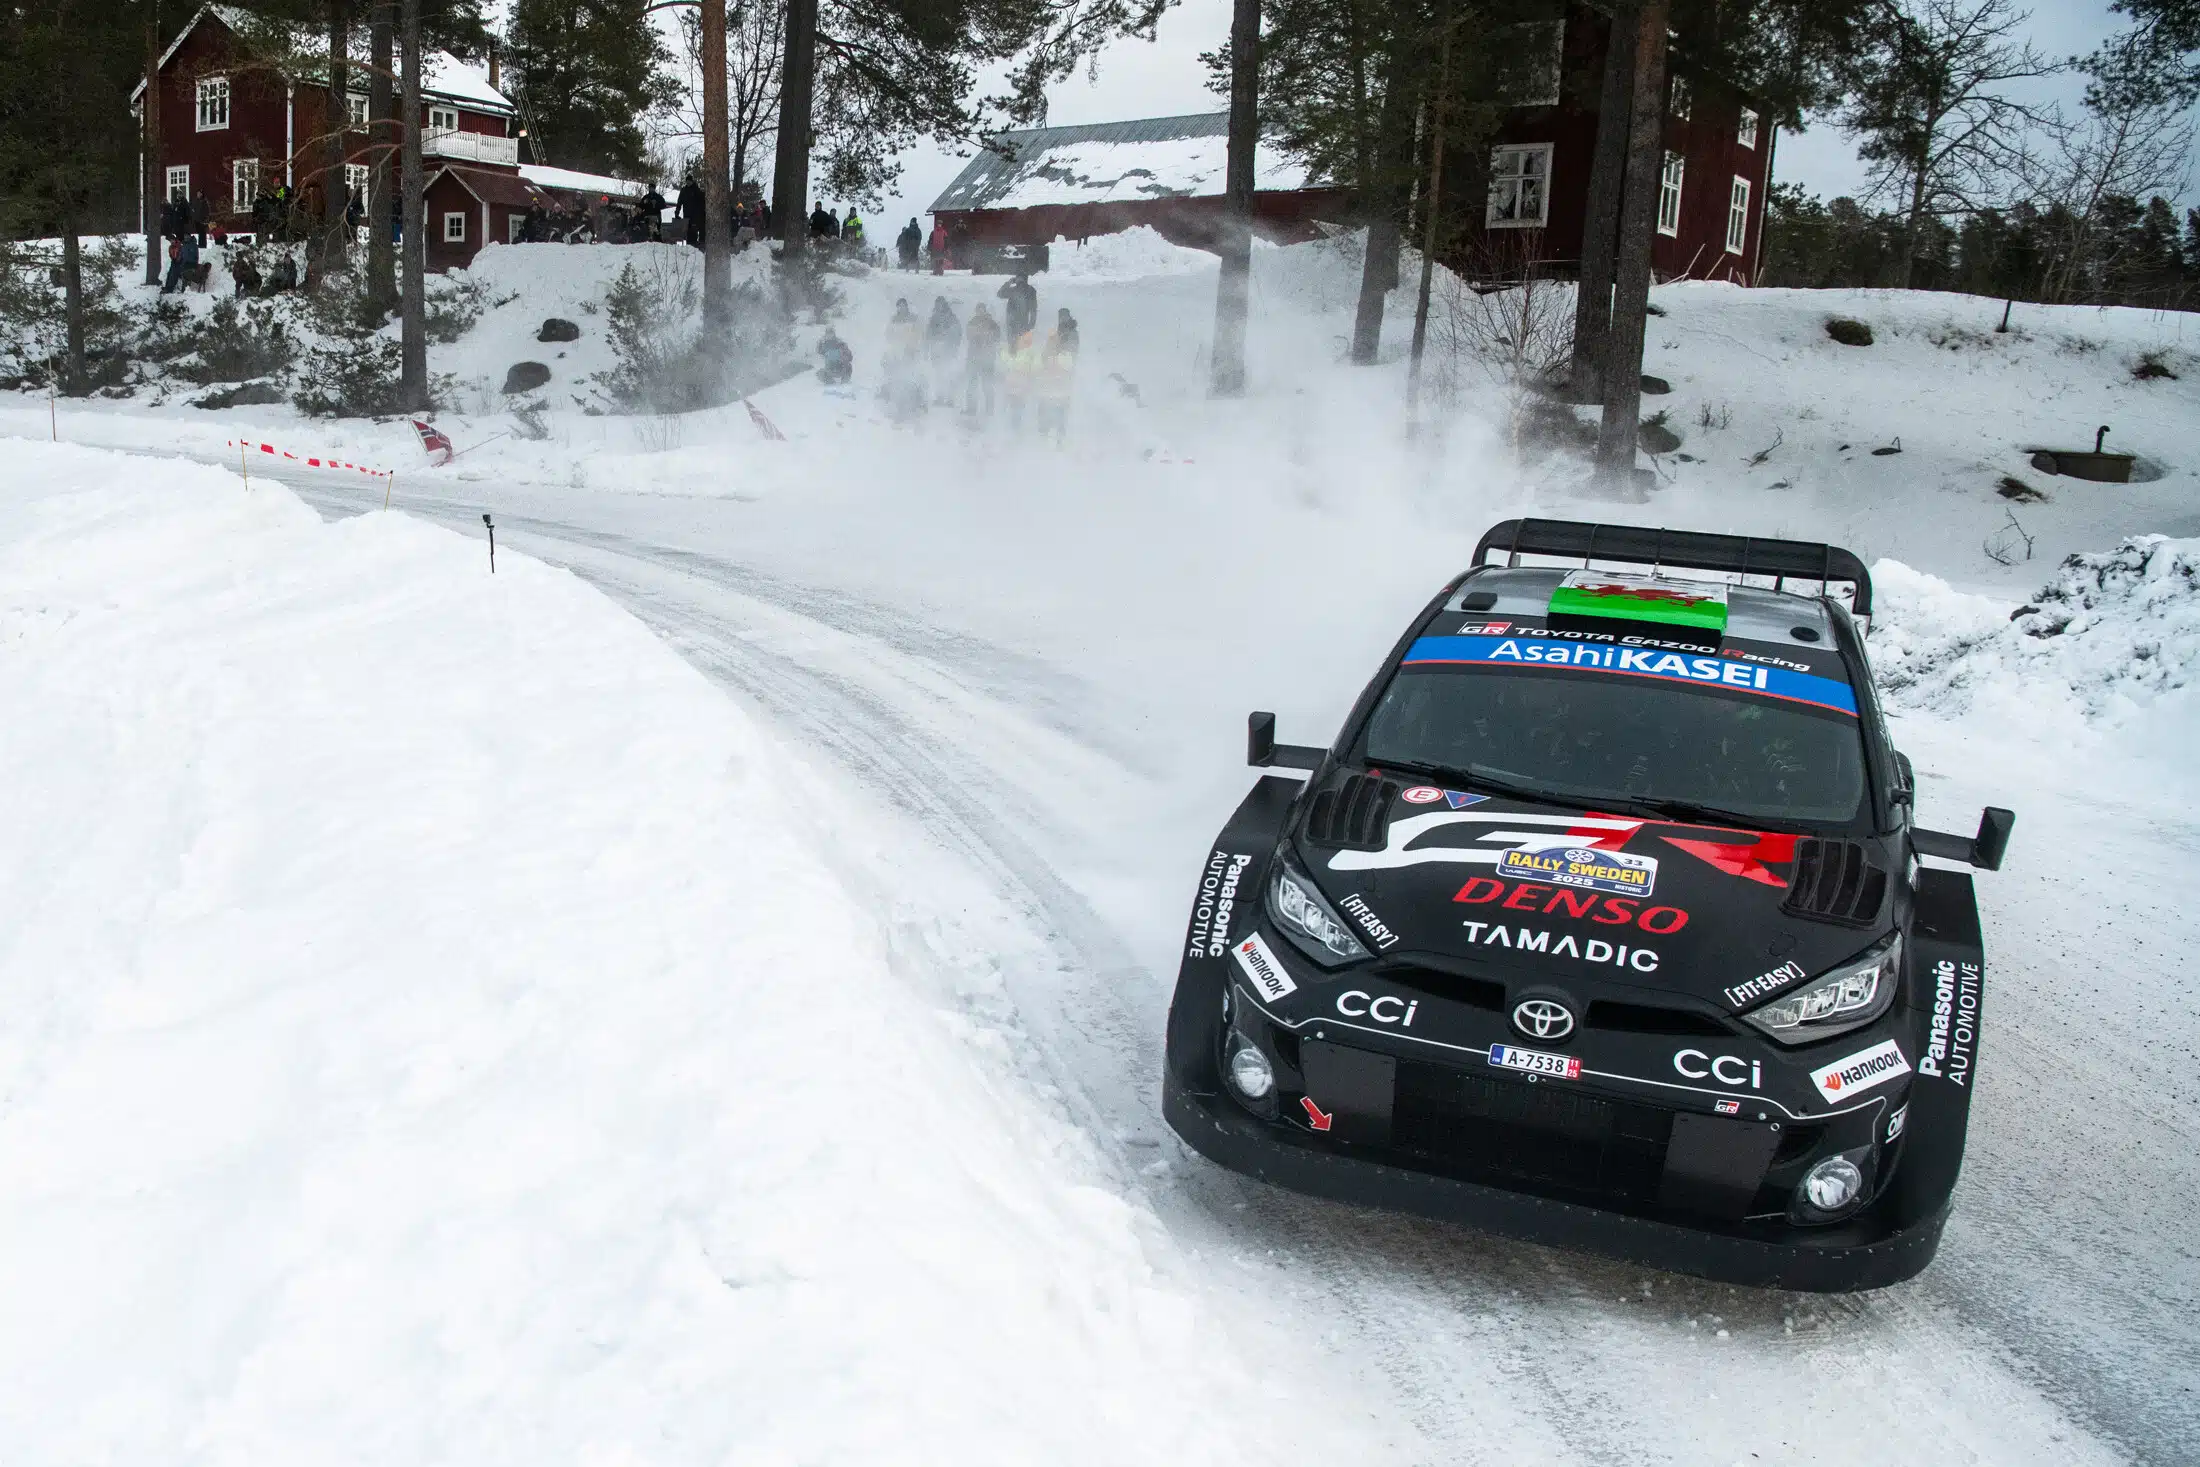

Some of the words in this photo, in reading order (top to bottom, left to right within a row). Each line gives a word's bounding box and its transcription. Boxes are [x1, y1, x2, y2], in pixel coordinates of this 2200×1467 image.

[1460, 625, 1507, 635] GR
[1515, 627, 1615, 642] TOYOTA
[1618, 635, 1716, 654] GAZOO
[1722, 648, 1811, 672] Racing
[1488, 640, 1768, 689] AsahiKASEI
[1508, 852, 1564, 872] RALLY
[1568, 862, 1647, 885] SWEDEN
[1552, 874, 1595, 886] 2025
[1624, 858, 1644, 867] 33
[1189, 850, 1229, 959] AUTOMOTIVE
[1209, 853, 1252, 958] Panasonic
[1452, 876, 1690, 935] DENSO
[1614, 884, 1643, 894] HISTORIC
[1462, 920, 1660, 973] TAMADIC
[1918, 959, 1956, 1078] Panasonic
[1949, 962, 1979, 1086] AUTOMOTIVE
[1507, 1051, 1565, 1073] A-7538
[1568, 1069, 1578, 1078] 25
[1570, 1059, 1580, 1068] 11
[1715, 1104, 1739, 1114] GR
